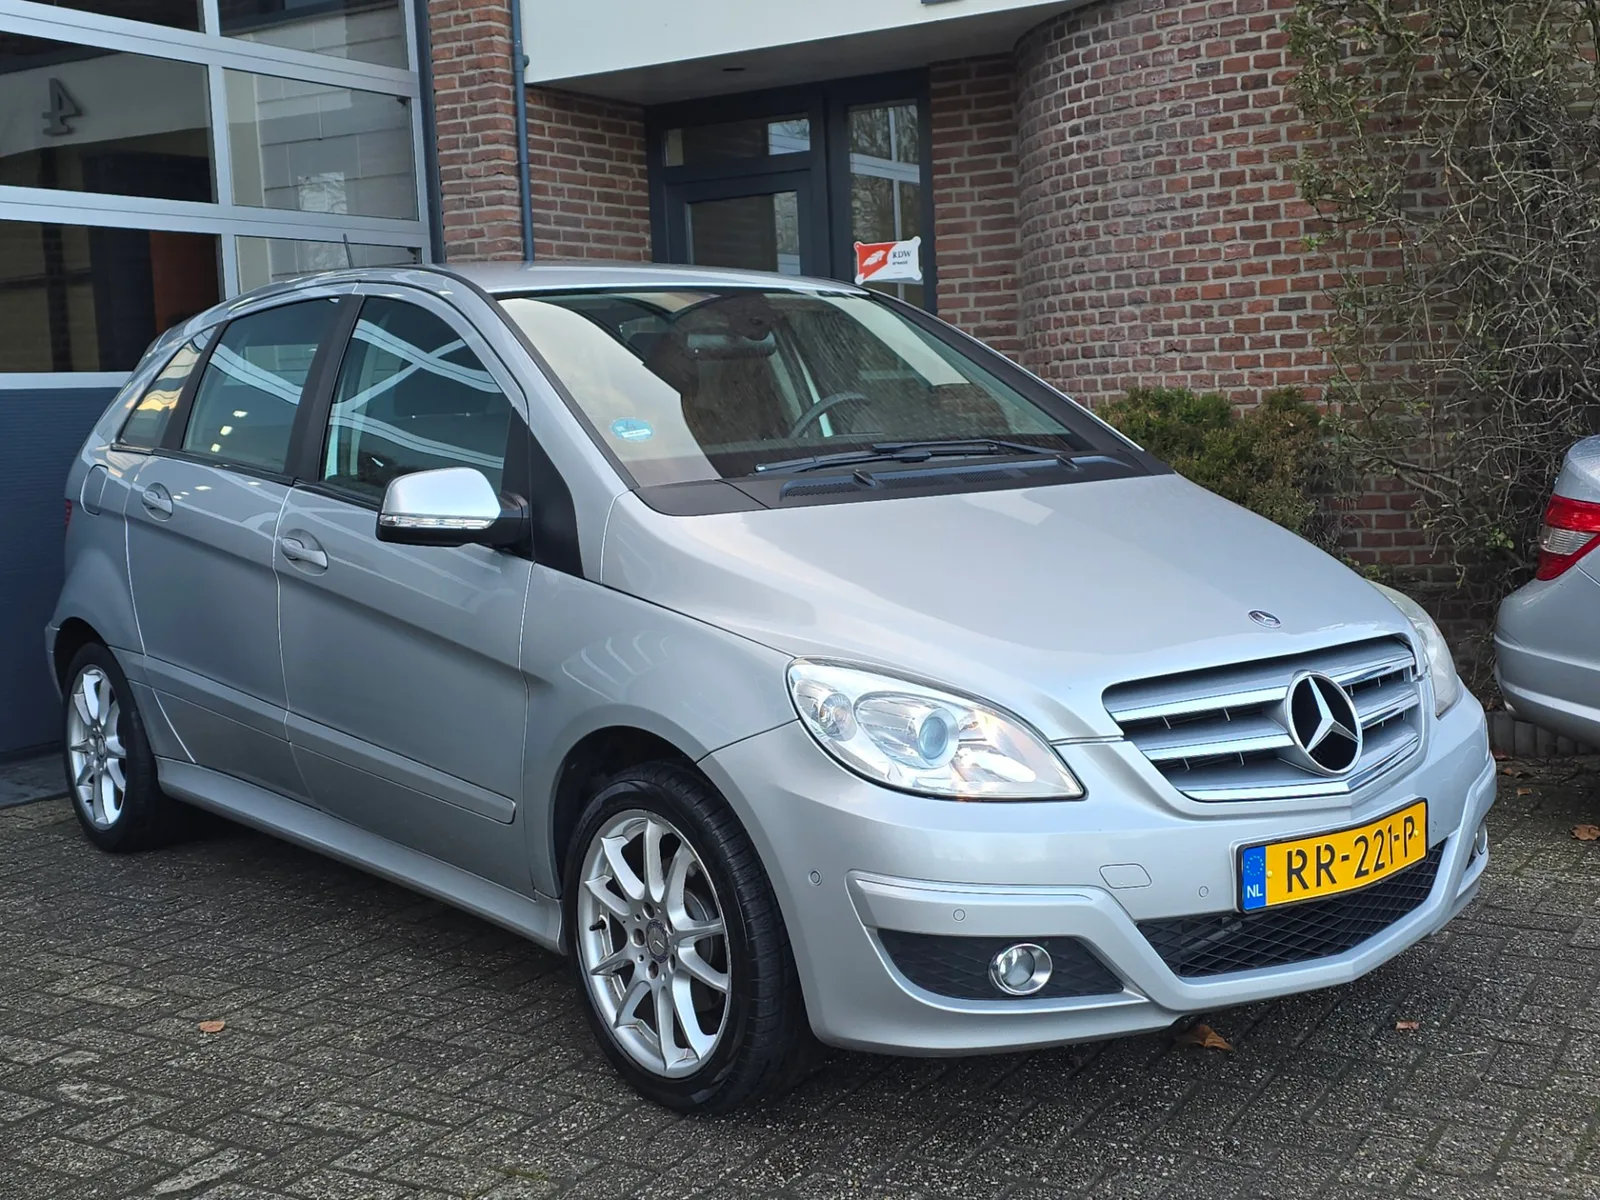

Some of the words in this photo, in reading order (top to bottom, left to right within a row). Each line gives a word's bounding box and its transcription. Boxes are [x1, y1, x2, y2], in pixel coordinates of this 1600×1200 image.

[892, 250, 912, 259] RDW
[1286, 815, 1416, 893] RR-221-P
[1246, 884, 1263, 899] NL
